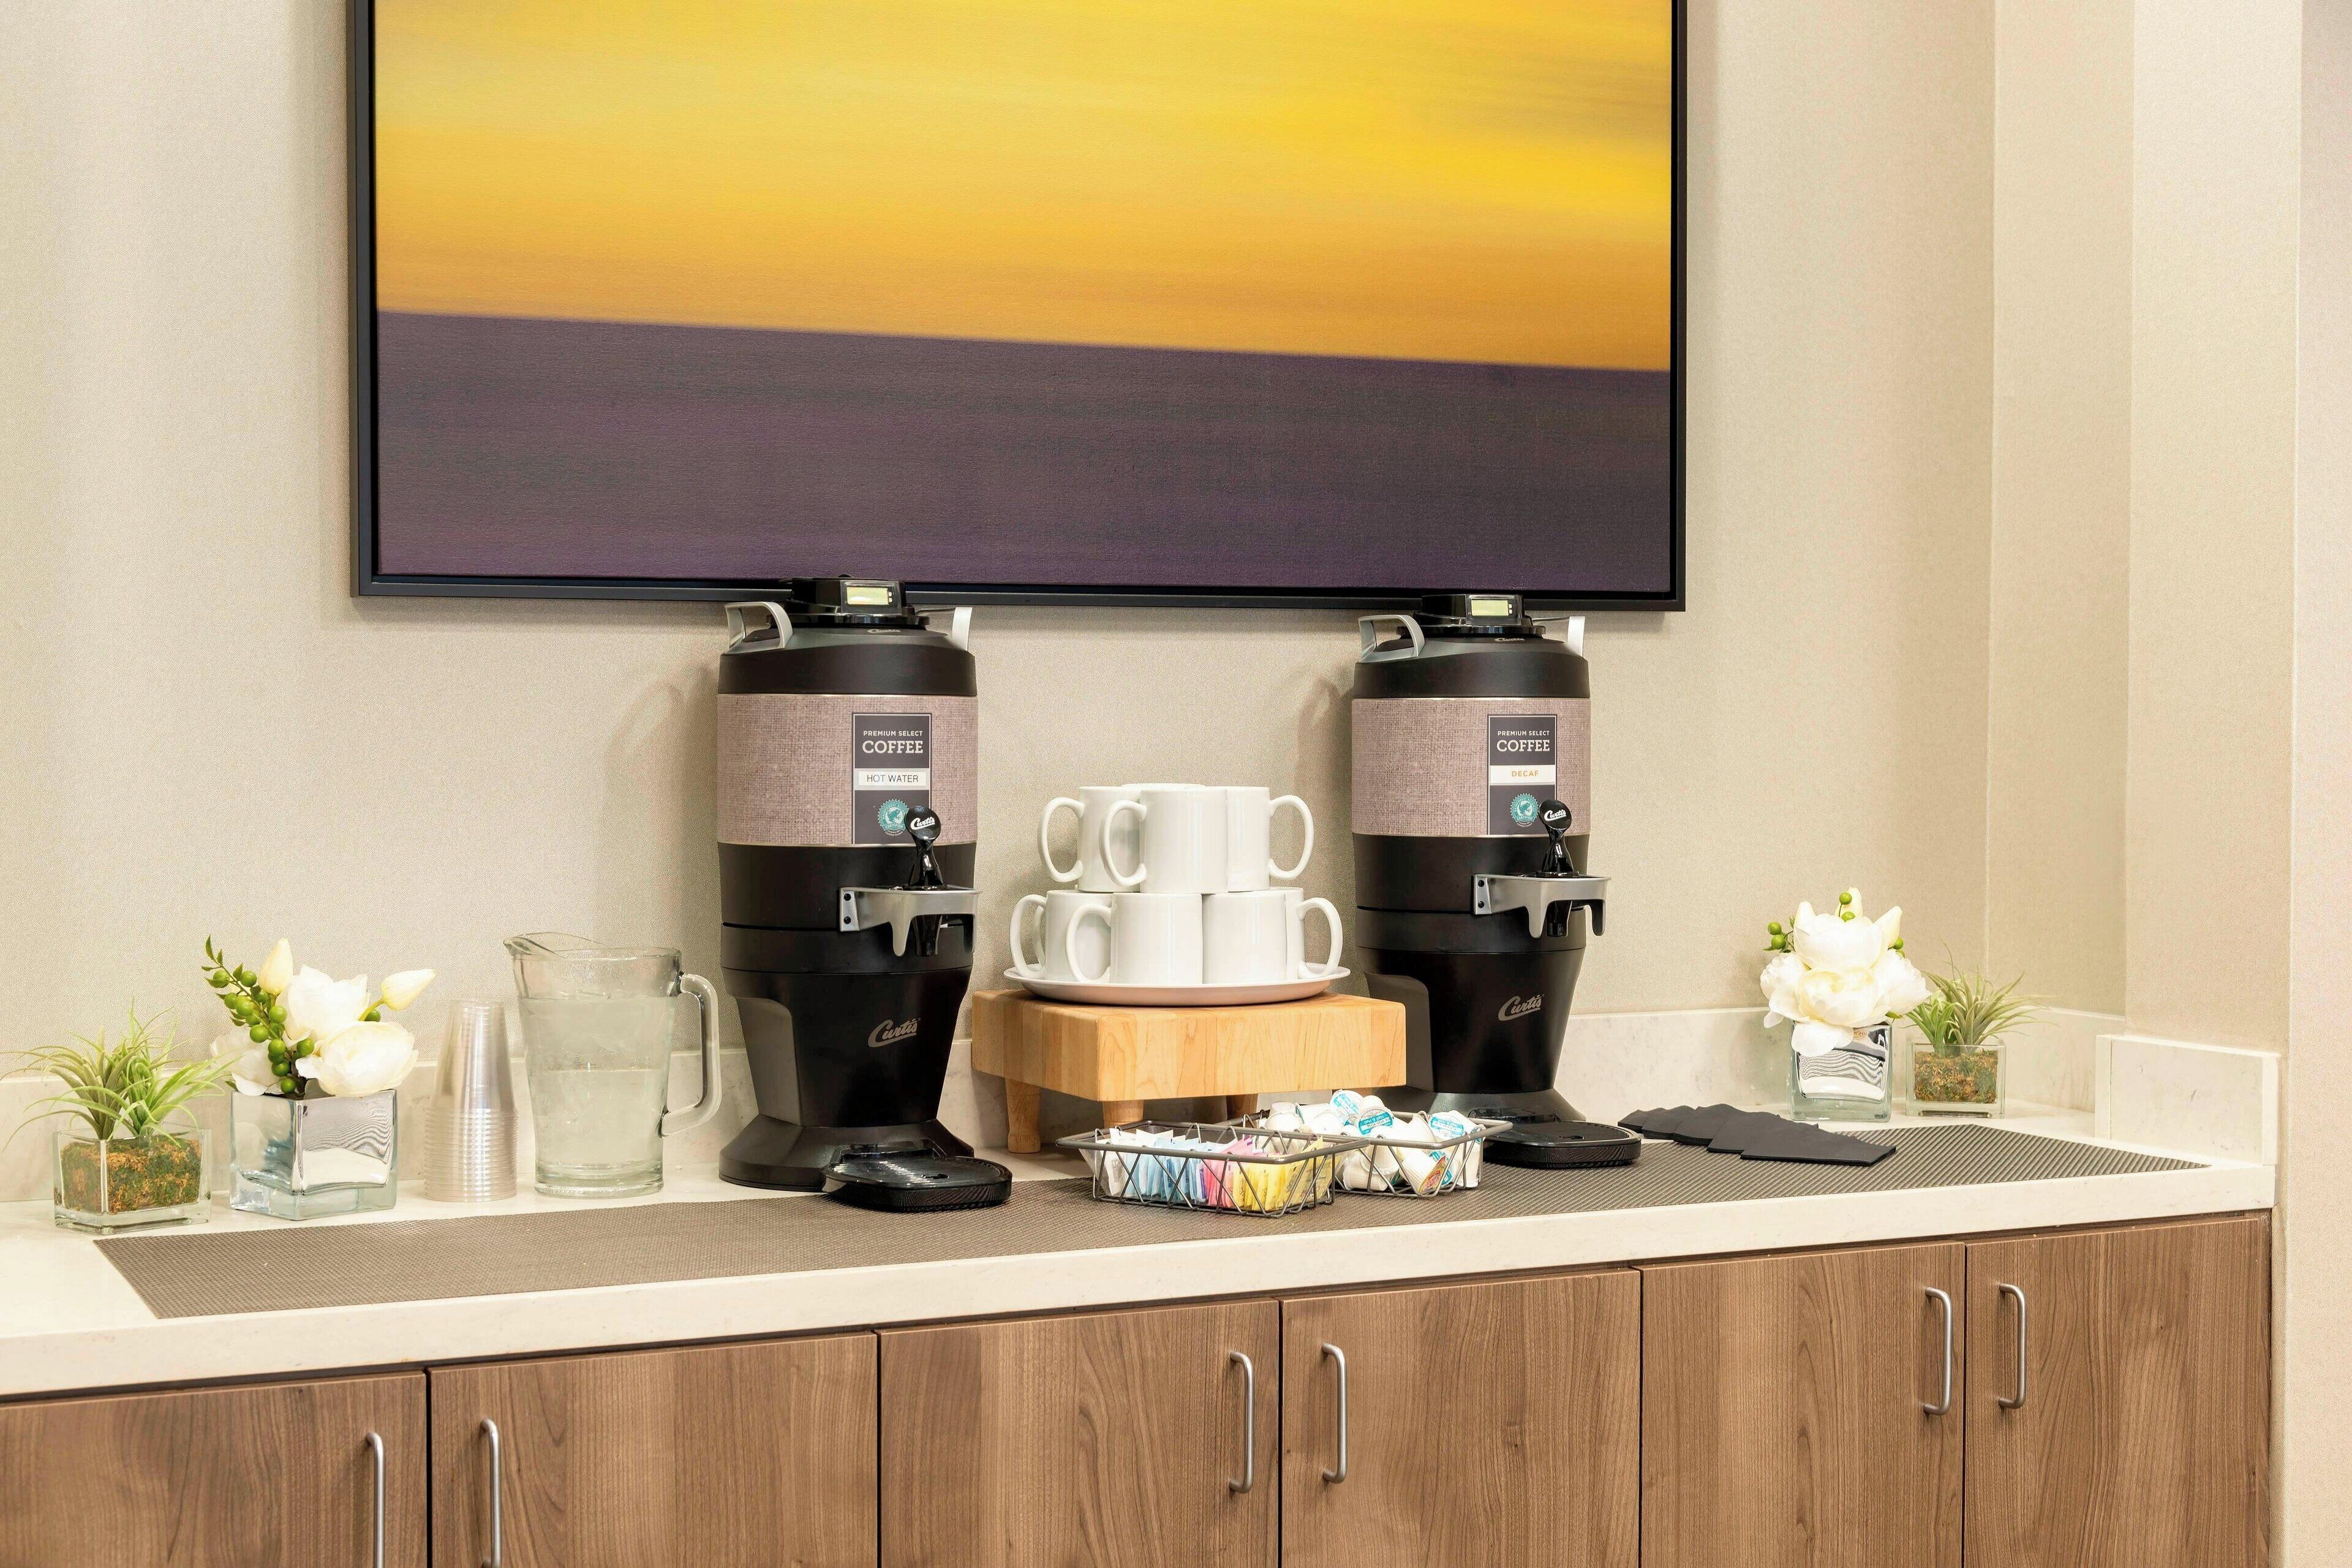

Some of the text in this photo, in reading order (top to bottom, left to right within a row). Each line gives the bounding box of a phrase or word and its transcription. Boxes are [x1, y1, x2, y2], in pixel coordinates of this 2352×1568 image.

[862, 740, 924, 754] COFFEE
[1496, 739, 1550, 752] COFFEE
[867, 774, 919, 783] HOT WATER
[1544, 809, 1567, 821] Curtis
[910, 816, 935, 831] Curtis
[1498, 994, 1542, 1021] Curtis
[868, 1018, 918, 1047] Curtis
